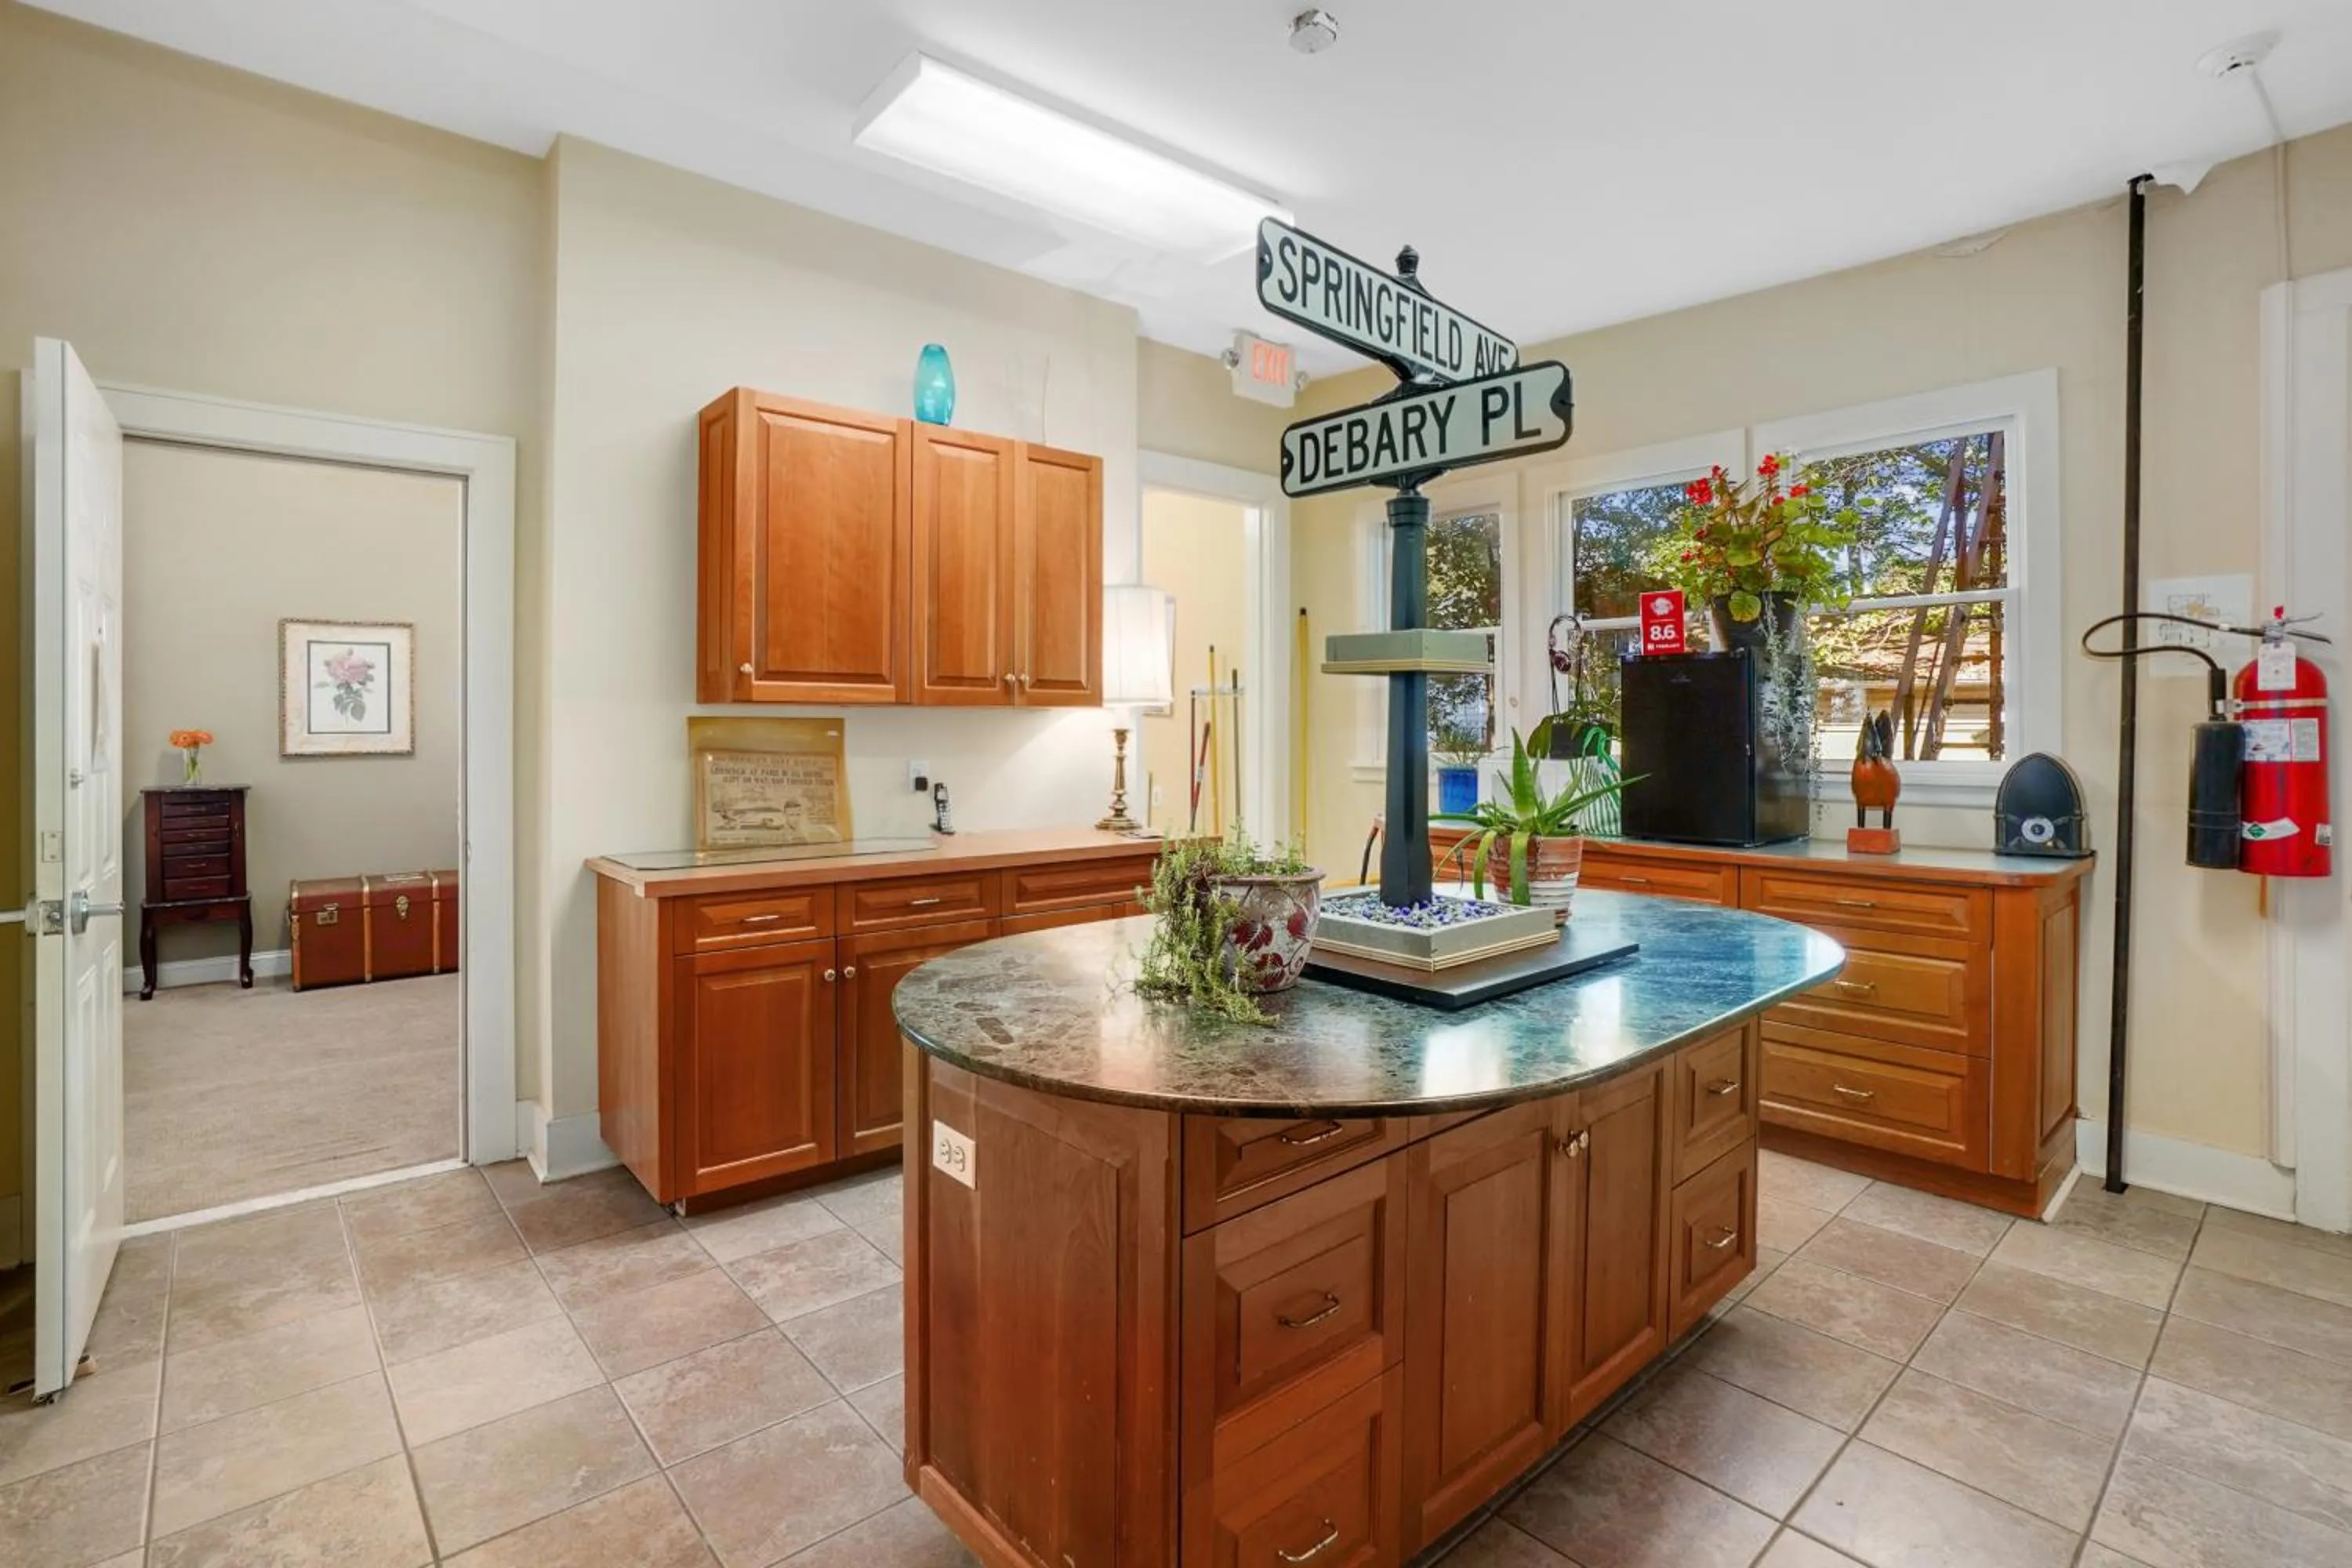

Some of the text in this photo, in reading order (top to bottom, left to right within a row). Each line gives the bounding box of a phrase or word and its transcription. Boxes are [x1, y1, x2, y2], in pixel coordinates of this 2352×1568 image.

[1278, 237, 1462, 372] SPRINGFIELD
[1253, 342, 1289, 387] EXIT
[1299, 381, 1542, 485] DEBARY PL
[1650, 624, 1676, 641] 8.6
